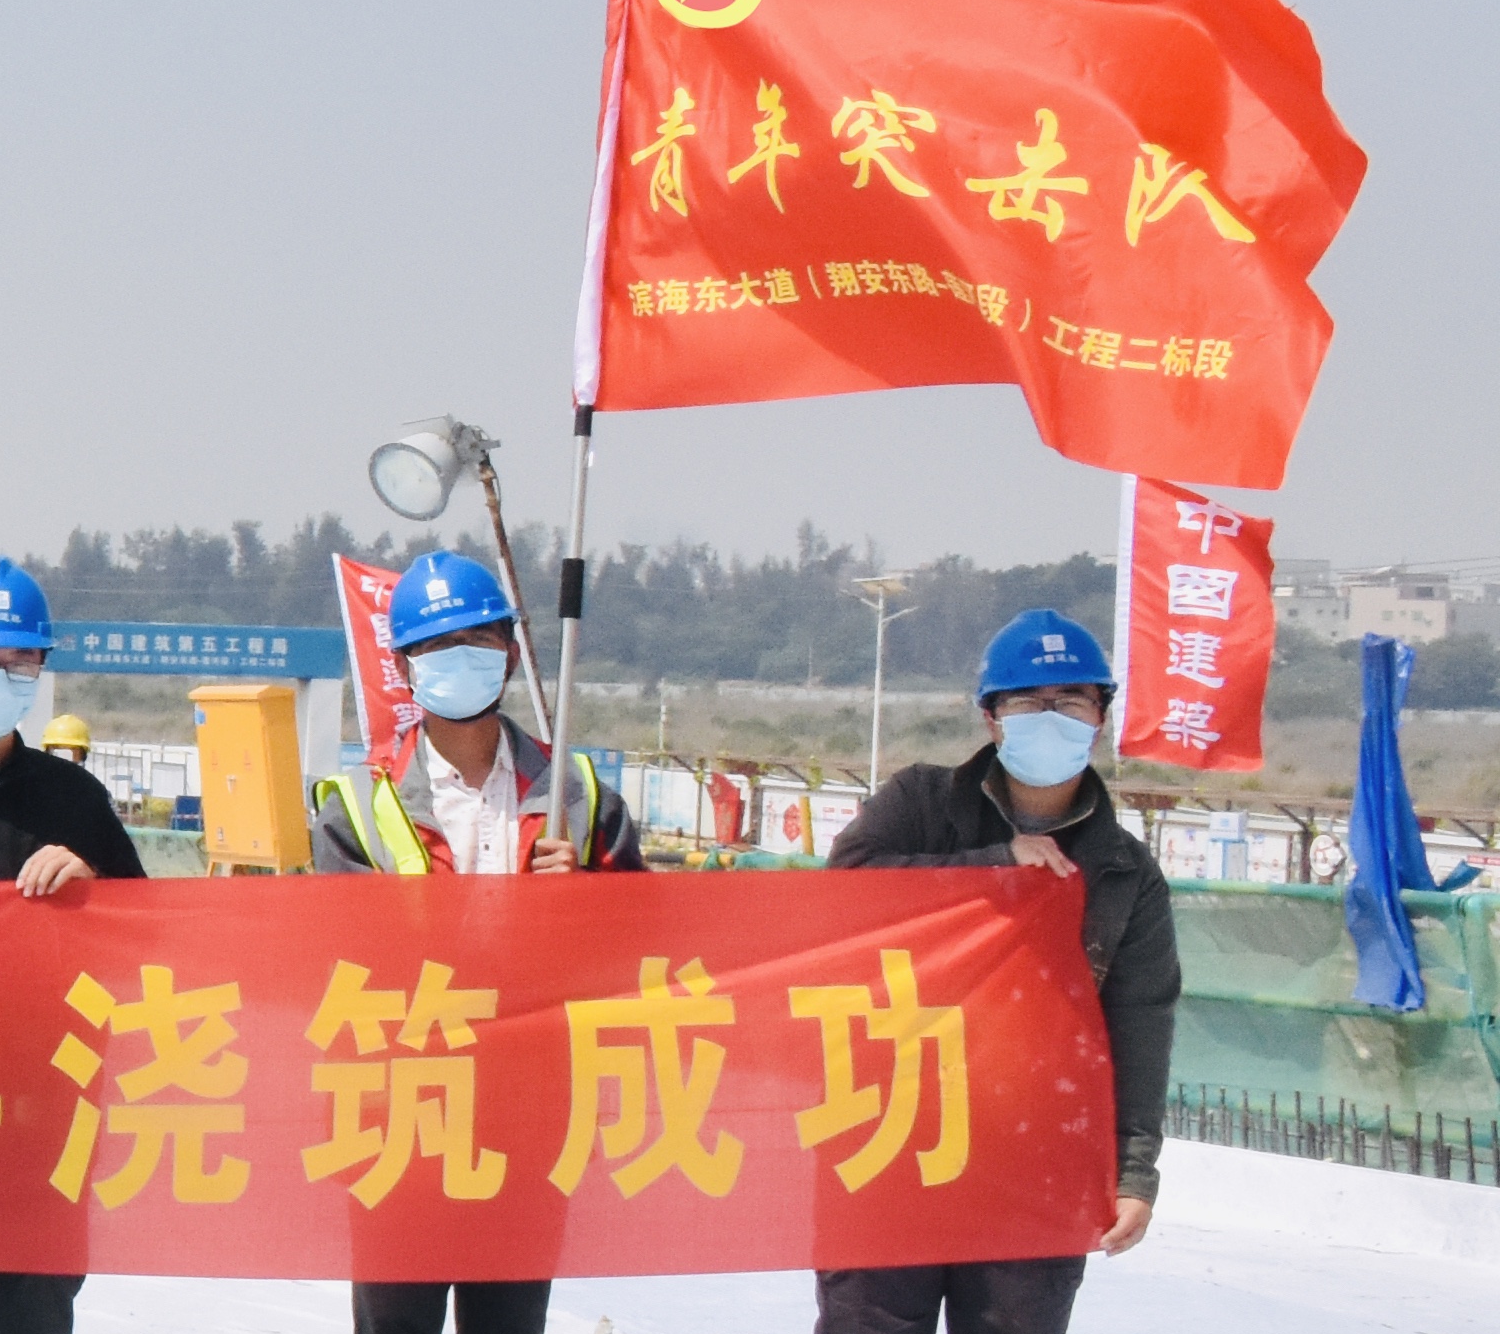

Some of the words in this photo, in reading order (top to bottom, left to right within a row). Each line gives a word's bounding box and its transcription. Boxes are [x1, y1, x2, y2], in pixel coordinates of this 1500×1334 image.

[630, 77, 1257, 247] 青年突击队
